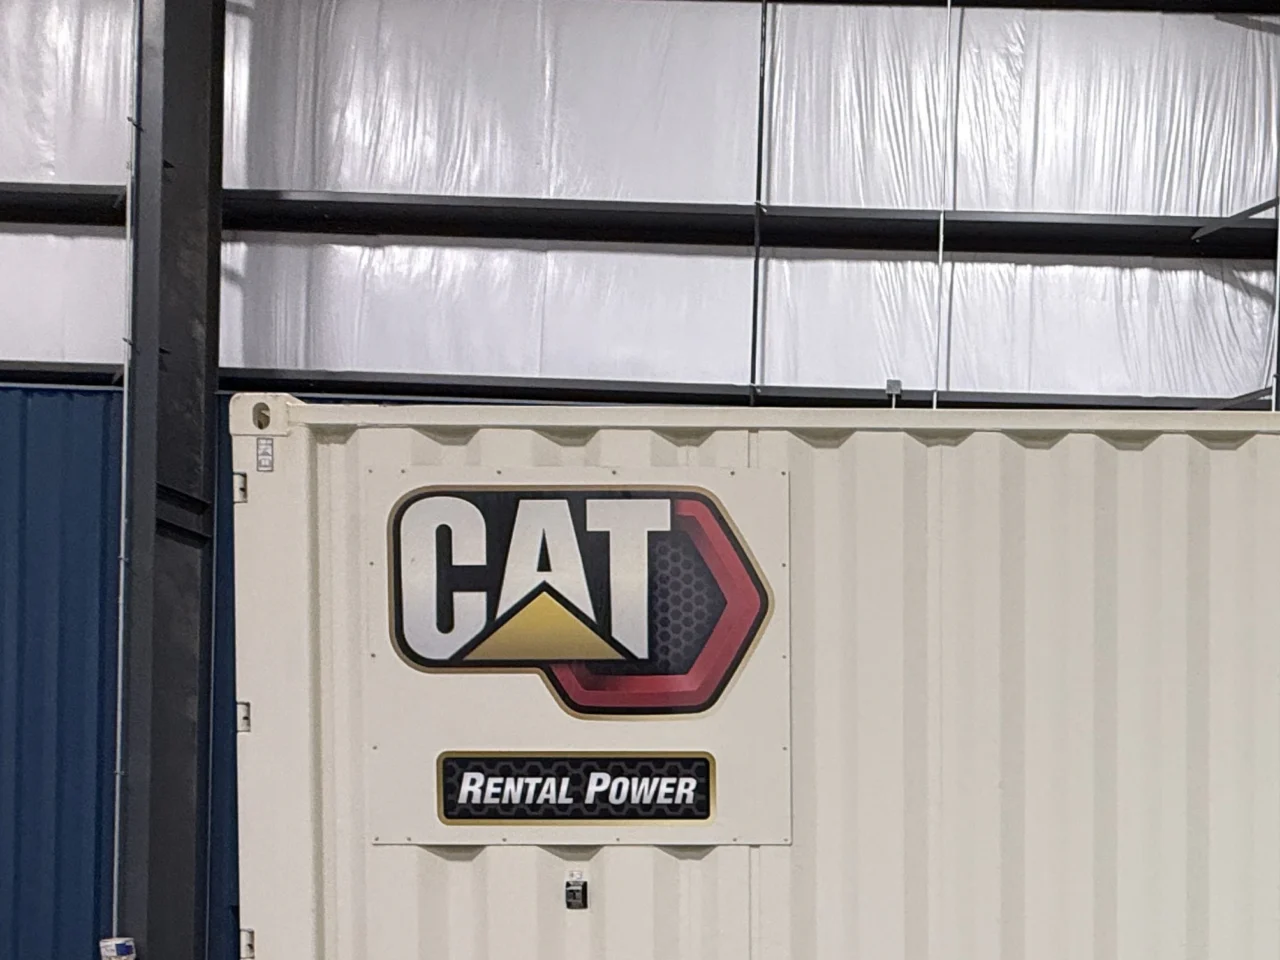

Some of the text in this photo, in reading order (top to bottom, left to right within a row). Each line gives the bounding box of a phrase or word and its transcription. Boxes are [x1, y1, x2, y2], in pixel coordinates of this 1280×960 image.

[401, 495, 671, 660] CAT
[457, 771, 698, 805] RENTAL POWER
